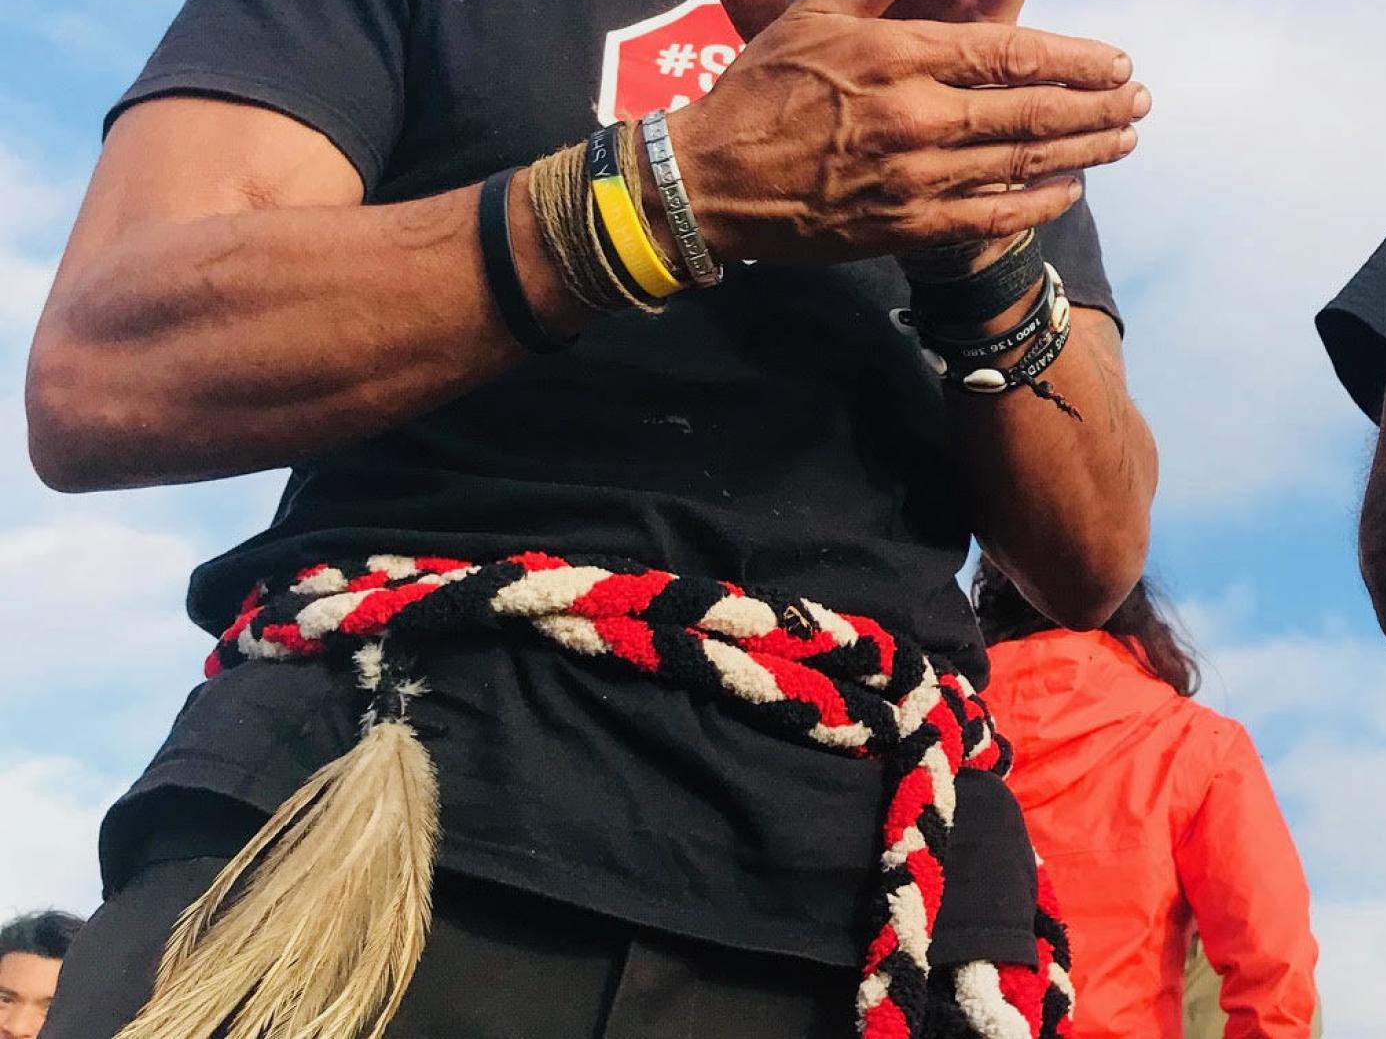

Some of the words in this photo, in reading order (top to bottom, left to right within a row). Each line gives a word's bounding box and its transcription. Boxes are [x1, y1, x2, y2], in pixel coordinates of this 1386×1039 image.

[656, 43, 747, 93] #S
[1016, 318, 1041, 341] 1800
[1027, 348, 1054, 376] NAID
